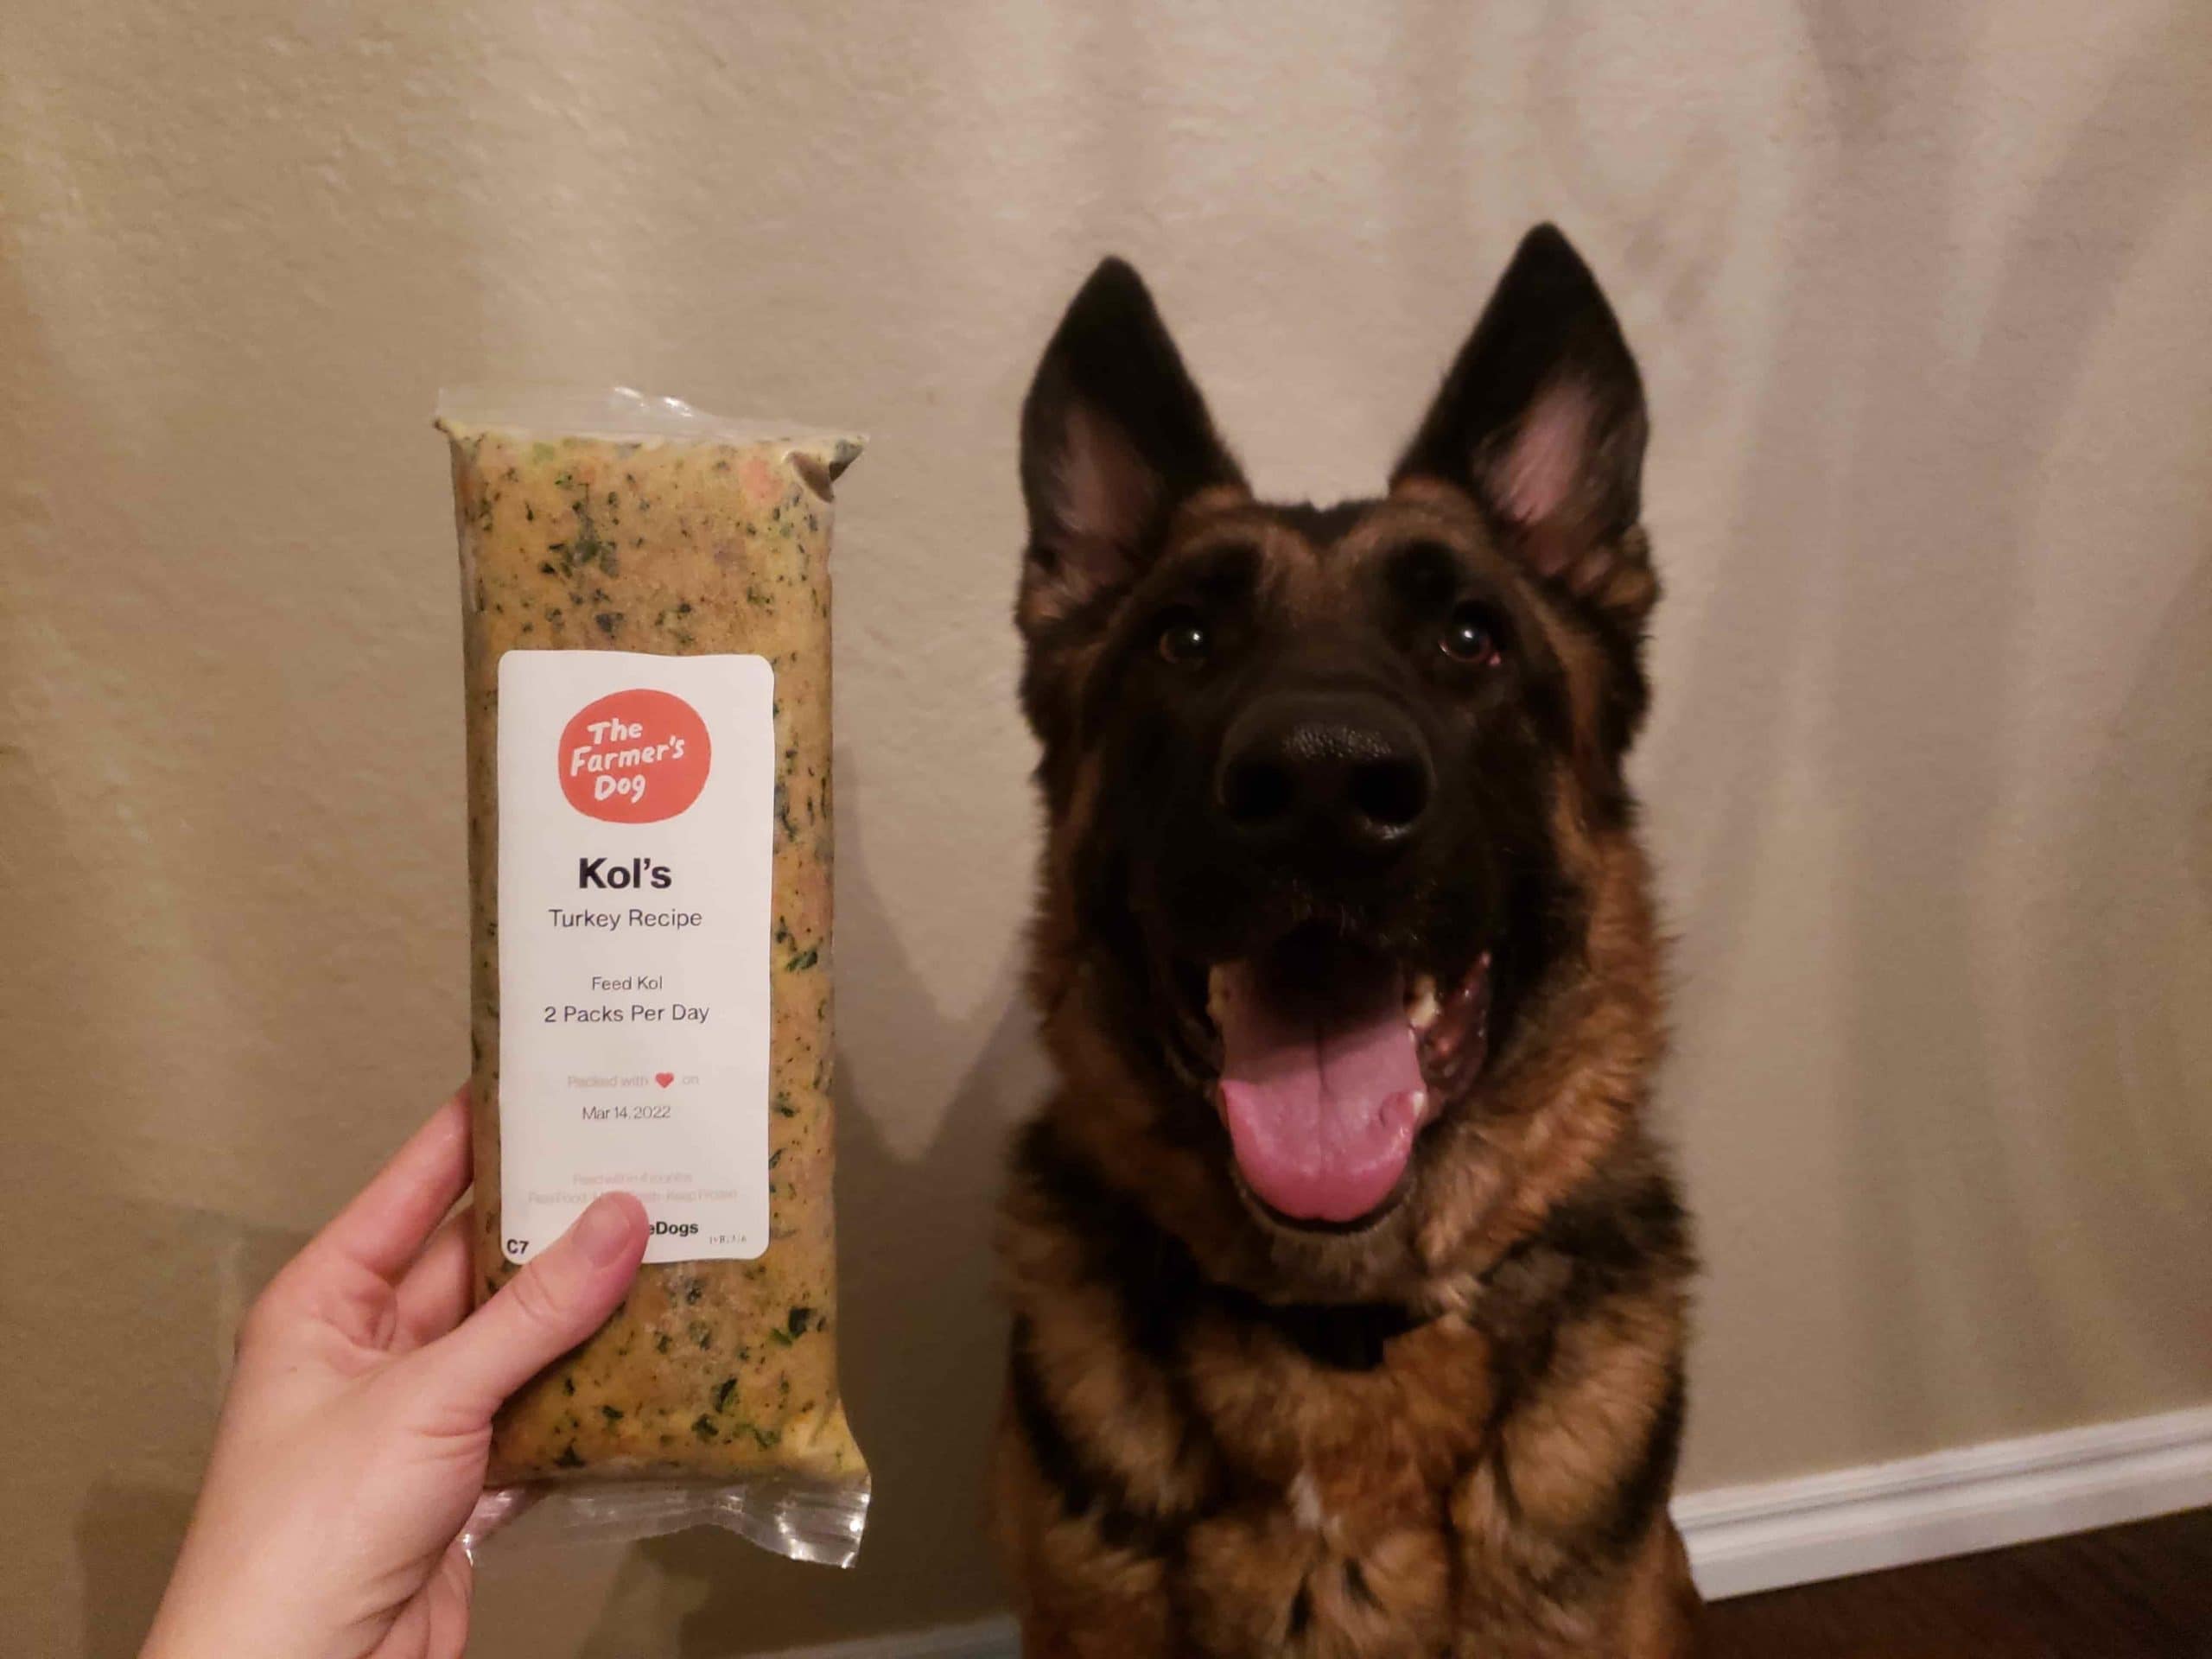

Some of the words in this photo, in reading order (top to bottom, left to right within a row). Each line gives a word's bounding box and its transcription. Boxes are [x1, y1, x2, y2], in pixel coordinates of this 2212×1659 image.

[587, 717, 643, 745] The
[569, 735, 685, 777] Farmer's
[594, 774, 646, 804] Dog
[579, 857, 672, 889] Kol’s
[549, 909, 621, 931] Turkey
[628, 908, 702, 930] Recipe
[592, 976, 632, 991] Feed
[637, 976, 663, 990] Kol
[544, 1006, 556, 1023] 2
[563, 1005, 624, 1022] Packs
[631, 1004, 665, 1021] Per
[672, 1003, 710, 1024] Day
[620, 1075, 648, 1087] with
[682, 1076, 699, 1086] on
[582, 1105, 611, 1120] Mar
[633, 1105, 671, 1120] 2022
[506, 1238, 529, 1255] C7
